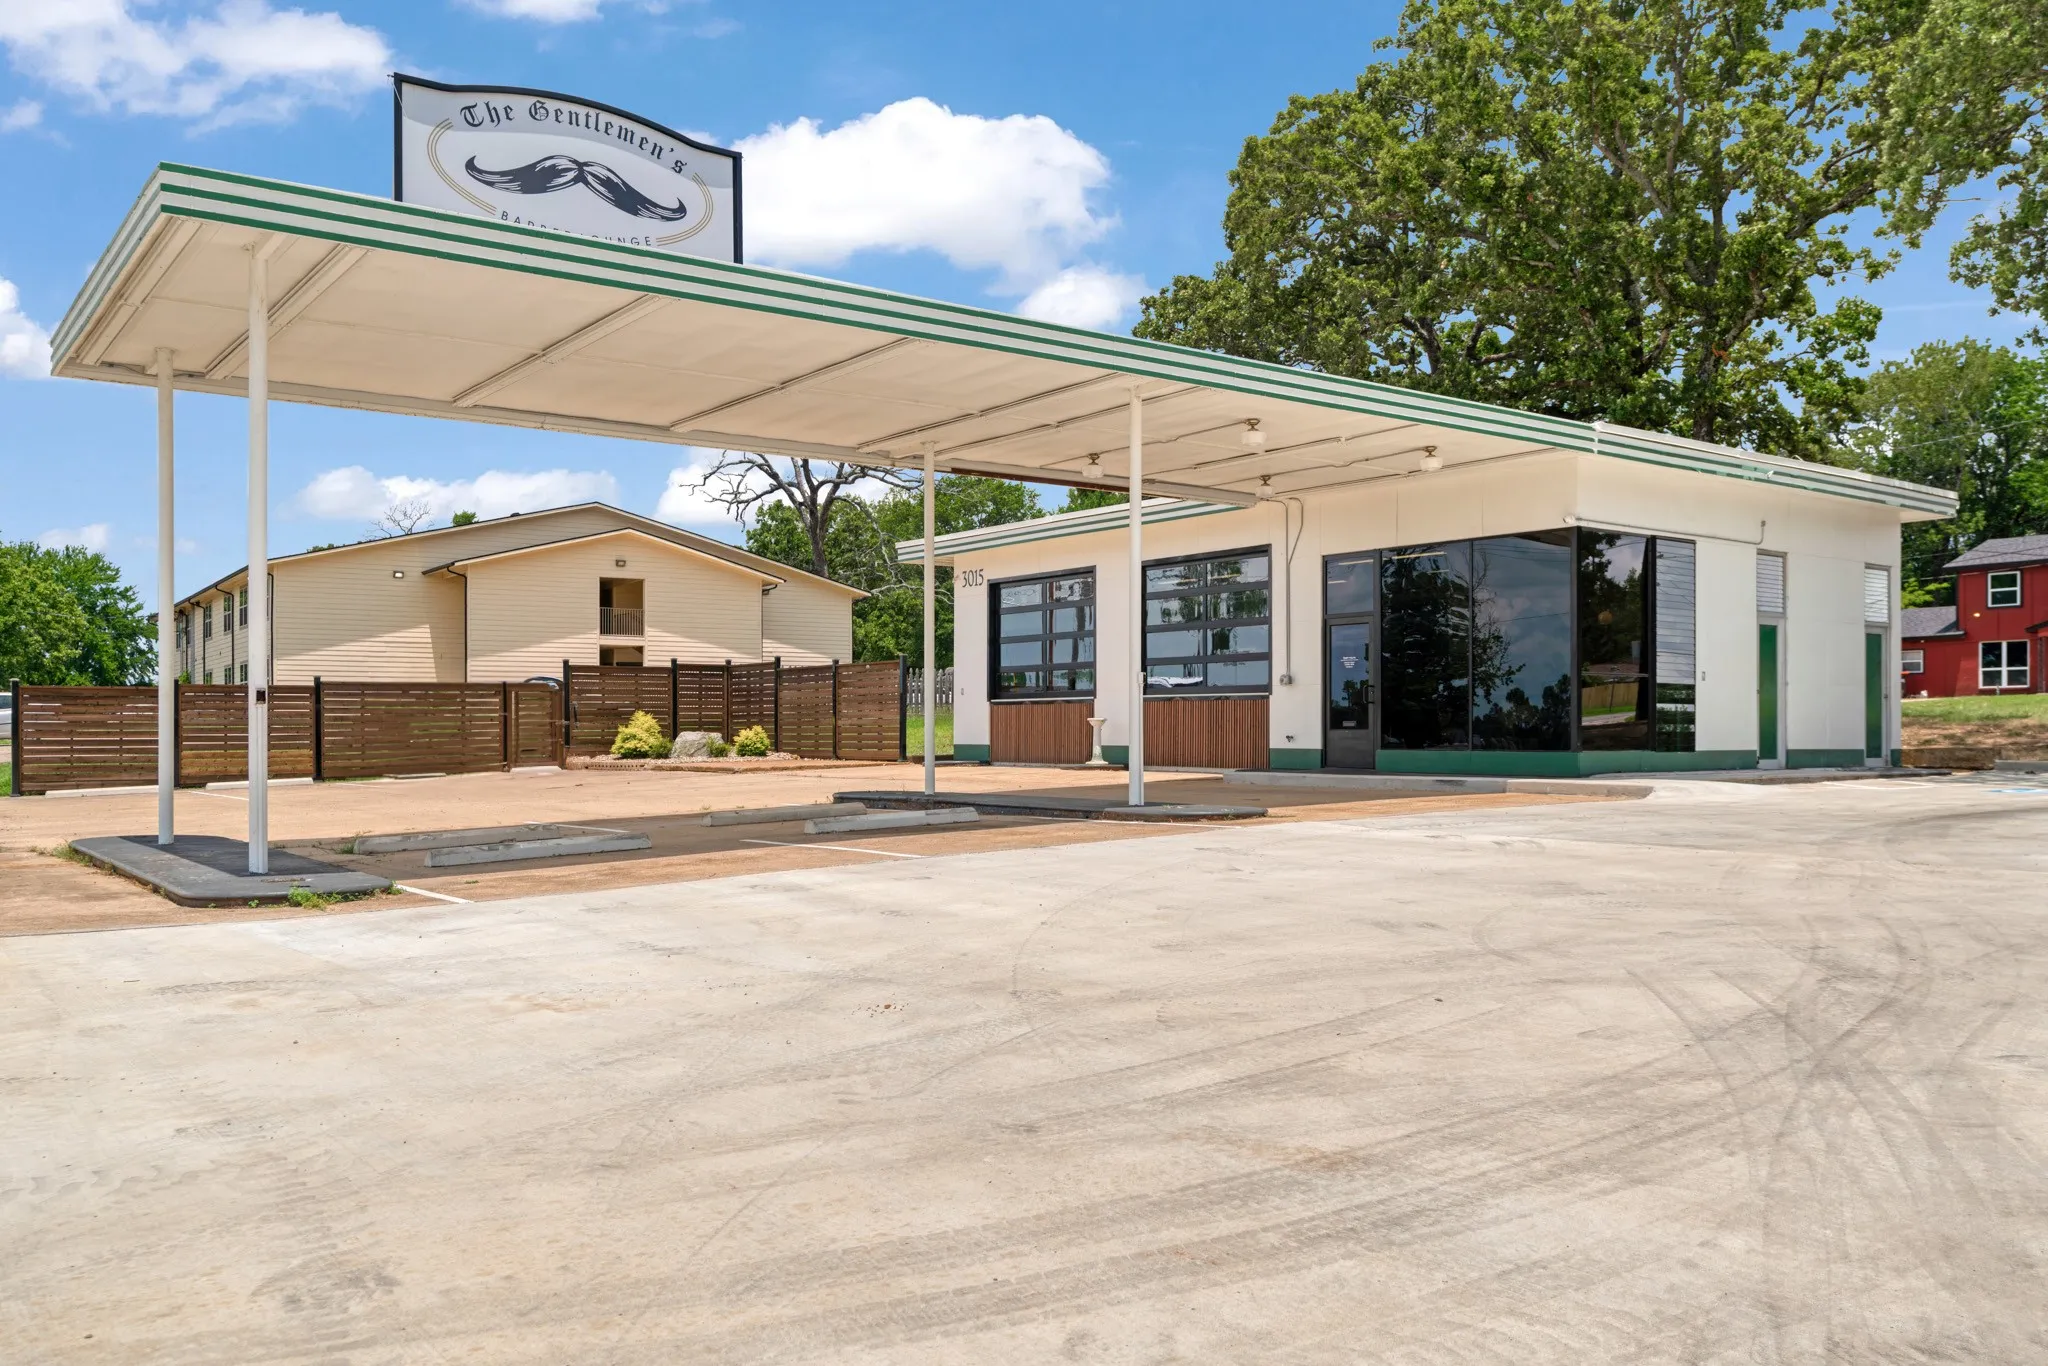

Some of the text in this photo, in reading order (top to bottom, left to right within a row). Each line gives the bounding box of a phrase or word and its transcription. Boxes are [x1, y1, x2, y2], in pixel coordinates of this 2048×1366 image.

[460, 100, 688, 174] The Gentlemen's
[962, 568, 984, 588] 3015
